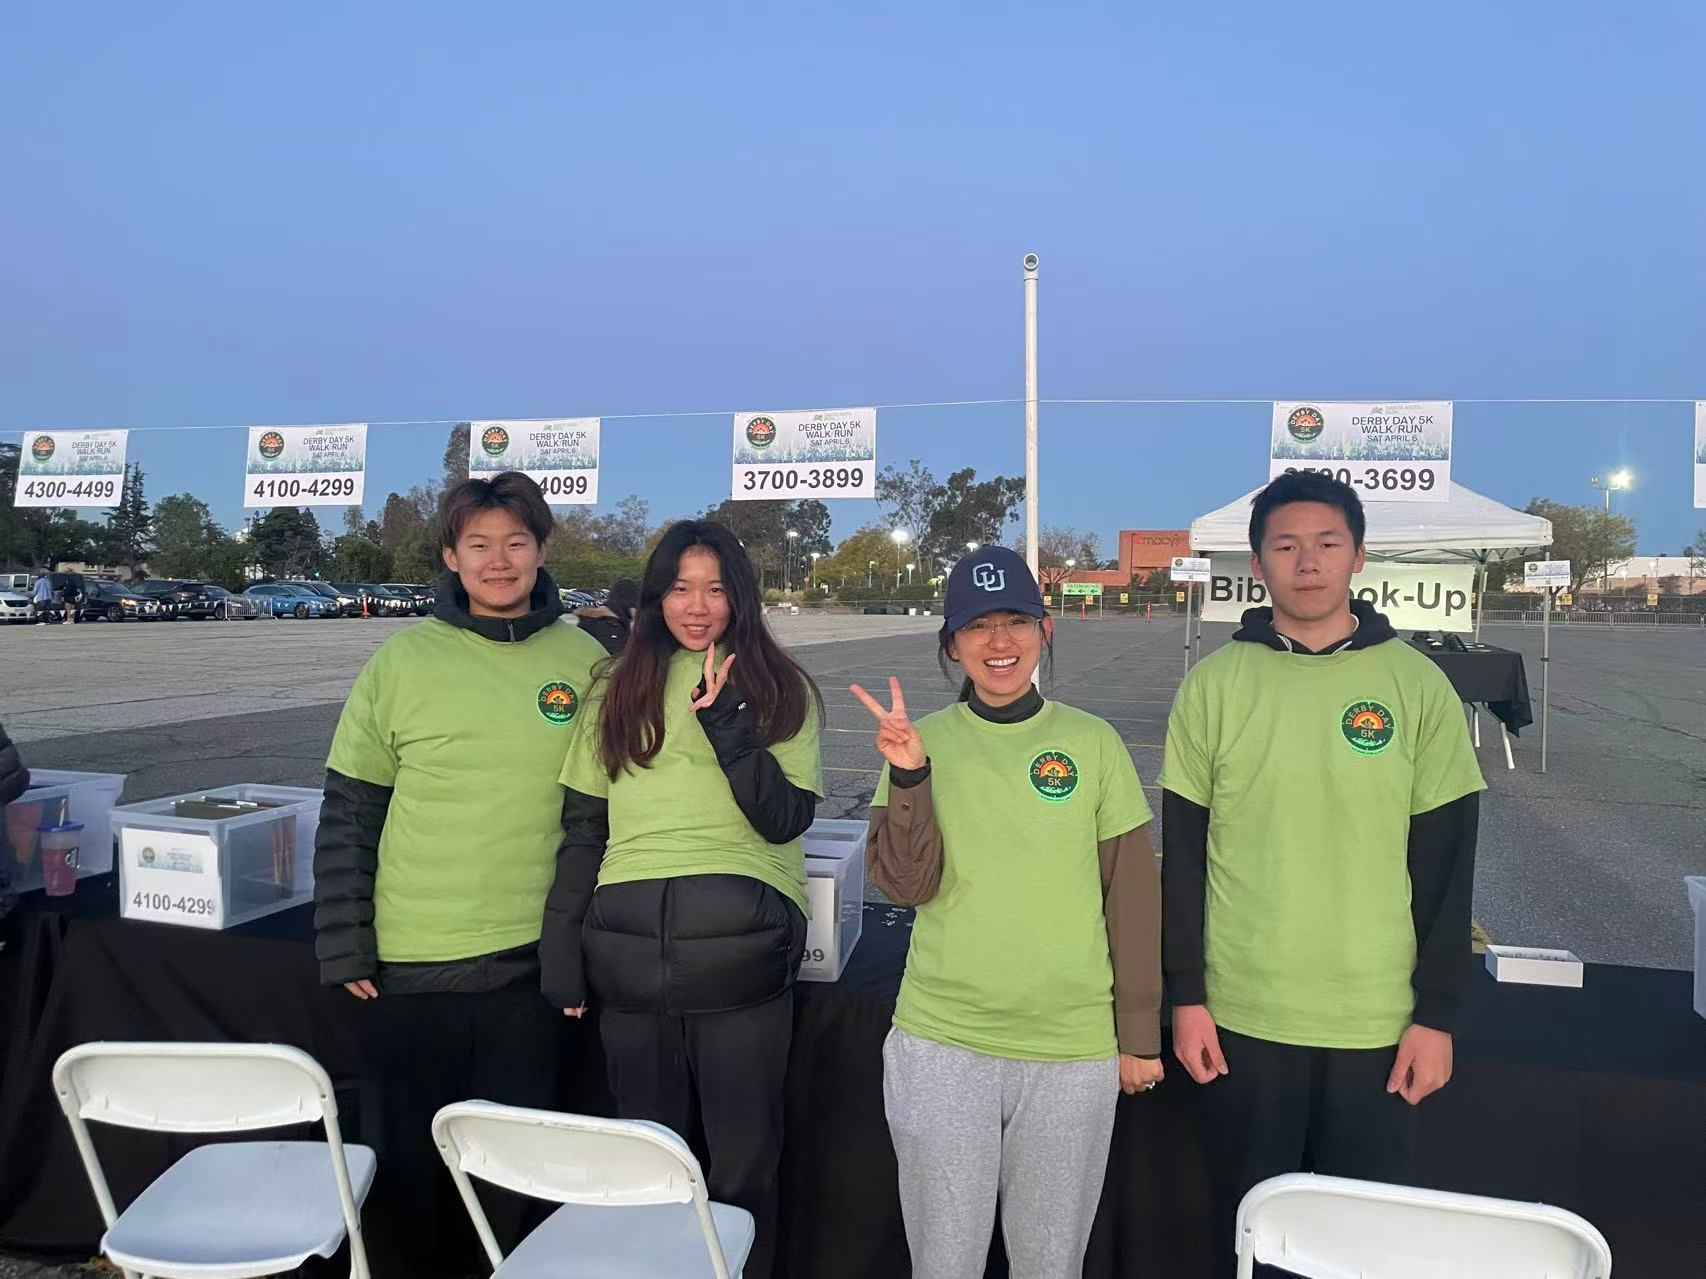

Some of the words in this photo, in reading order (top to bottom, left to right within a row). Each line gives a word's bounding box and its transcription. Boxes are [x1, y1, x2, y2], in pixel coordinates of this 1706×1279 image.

[1291, 408, 1310, 424] DERBY
[1352, 416, 1390, 426] DERBY
[1392, 416, 1416, 425] DAY
[1418, 416, 1434, 424] 5K
[530, 432, 556, 440] DERBY
[576, 431, 587, 439] 5K
[798, 422, 828, 432] DERBY
[830, 422, 848, 430] DAY
[850, 420, 861, 429] 5K
[254, 478, 354, 498] 4100-4299
[540, 476, 588, 495] 4099
[744, 468, 864, 490] 3700-3899
[1284, 467, 1435, 491] 0-3699
[24, 481, 114, 498] 4300-4499
[972, 562, 1006, 592] CU
[1210, 576, 1266, 604] Bib
[1348, 581, 1467, 616] ok-Up
[1346, 705, 1374, 725] DERBY
[1377, 710, 1392, 729] DAY
[1360, 730, 1376, 738] 5K
[1034, 754, 1058, 774] DERBY
[1062, 758, 1075, 777] DAY
[1048, 778, 1062, 786] 5K
